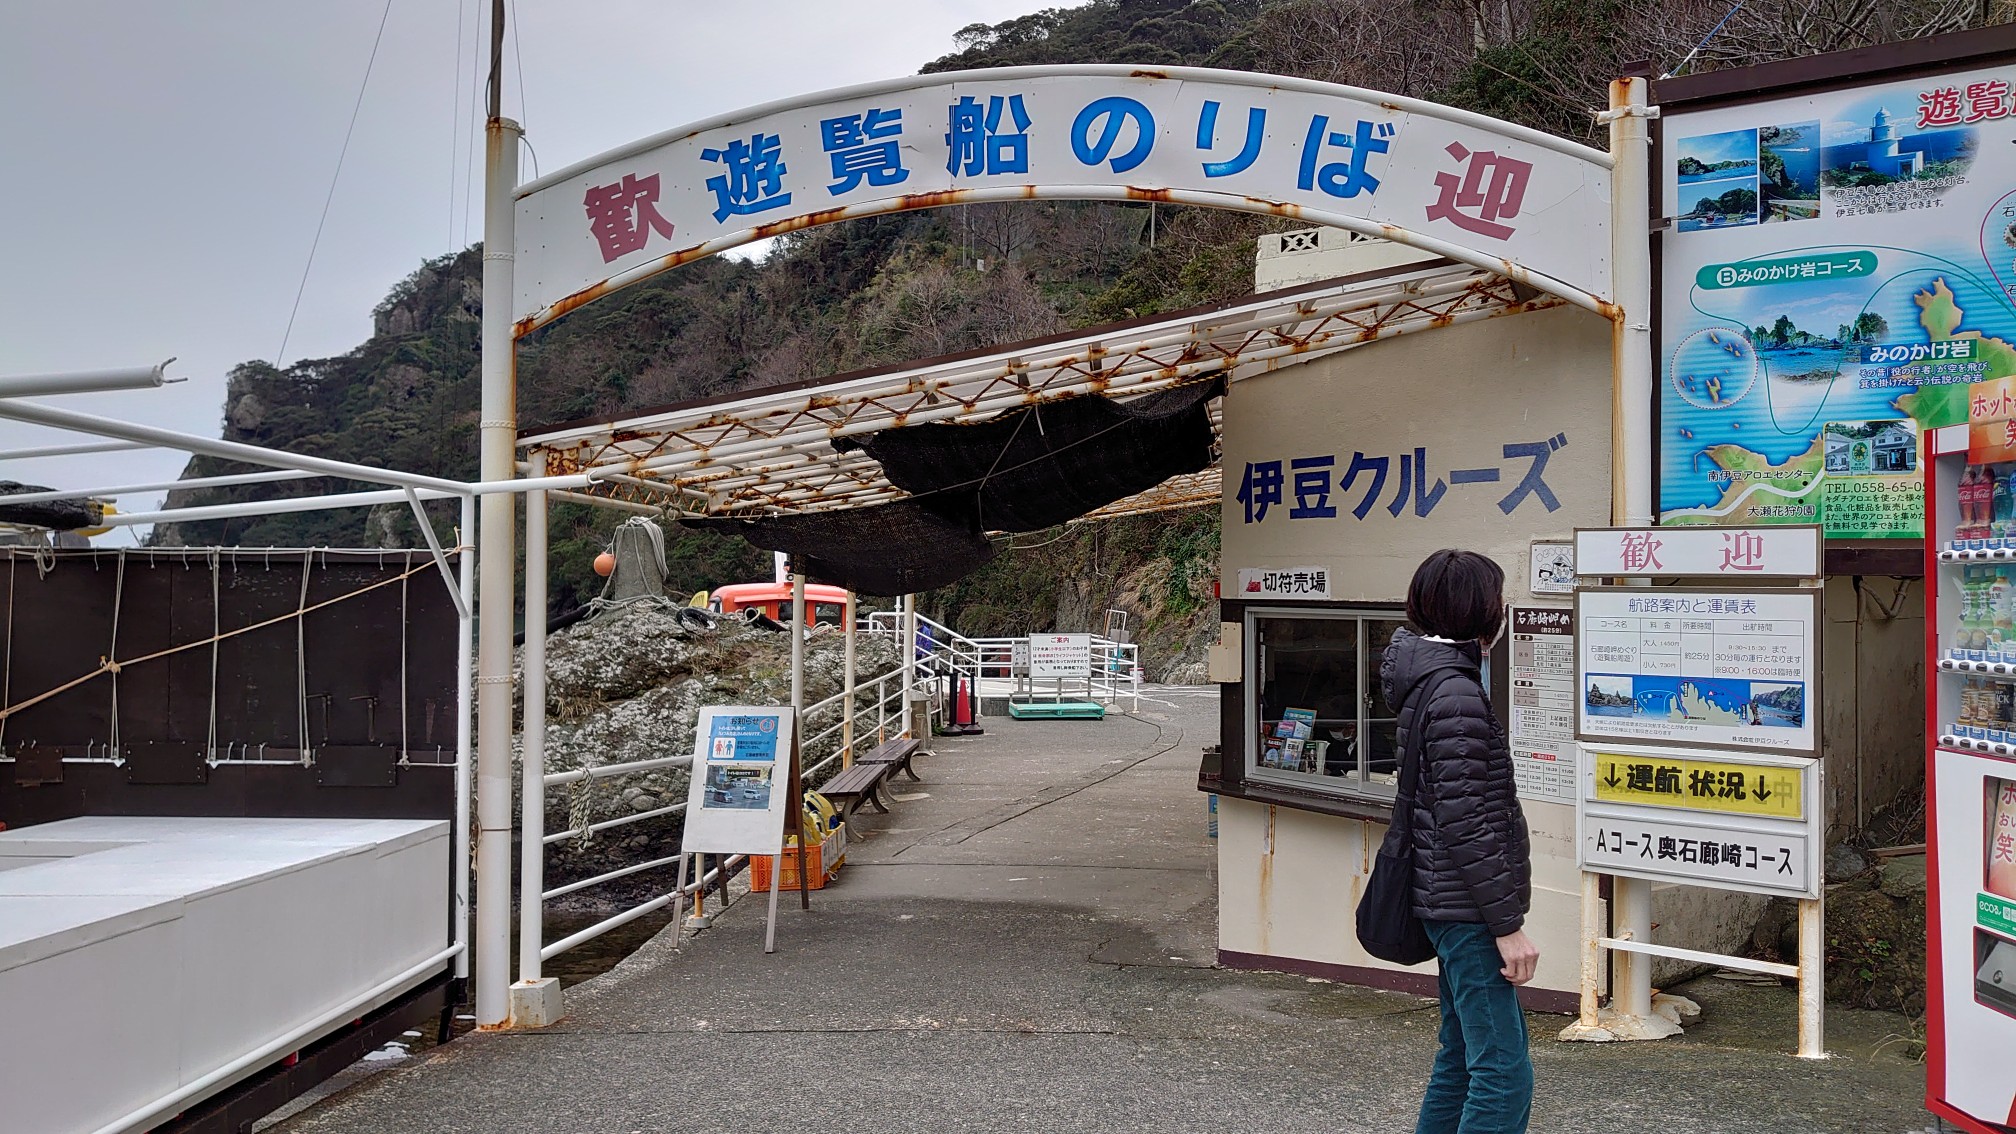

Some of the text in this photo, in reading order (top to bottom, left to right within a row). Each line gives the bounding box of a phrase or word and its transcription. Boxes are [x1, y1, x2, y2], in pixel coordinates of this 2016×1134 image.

[1916, 80, 2016, 128] 遊覧
[582, 93, 1534, 264] 歓 遊覧船のりば 迎
[1869, 341, 1970, 363] みのかけ岩
[1972, 387, 2016, 417] ホット
[1235, 432, 1569, 524] 伊豆クルーズ
[1708, 469, 1813, 481] 南伊豆アロエセンター
[1747, 504, 1815, 517] 大瀬花狩り園
[1619, 530, 1764, 572] 歓 迎
[1262, 571, 1327, 594] 切符売場
[1629, 598, 1757, 615] 航路案内と運賃表
[1516, 611, 1573, 626] 石廊崎岬め
[1600, 620, 1628, 628] コース名
[1682, 621, 1711, 630] 所要時間
[1684, 652, 1710, 661] 約25分
[1772, 645, 1787, 653] まで
[1714, 653, 1802, 664] 30分毎の運行となります
[731, 717, 759, 725] お知らせ
[1626, 764, 1682, 795] 運航
[1688, 770, 1747, 801] 状況
